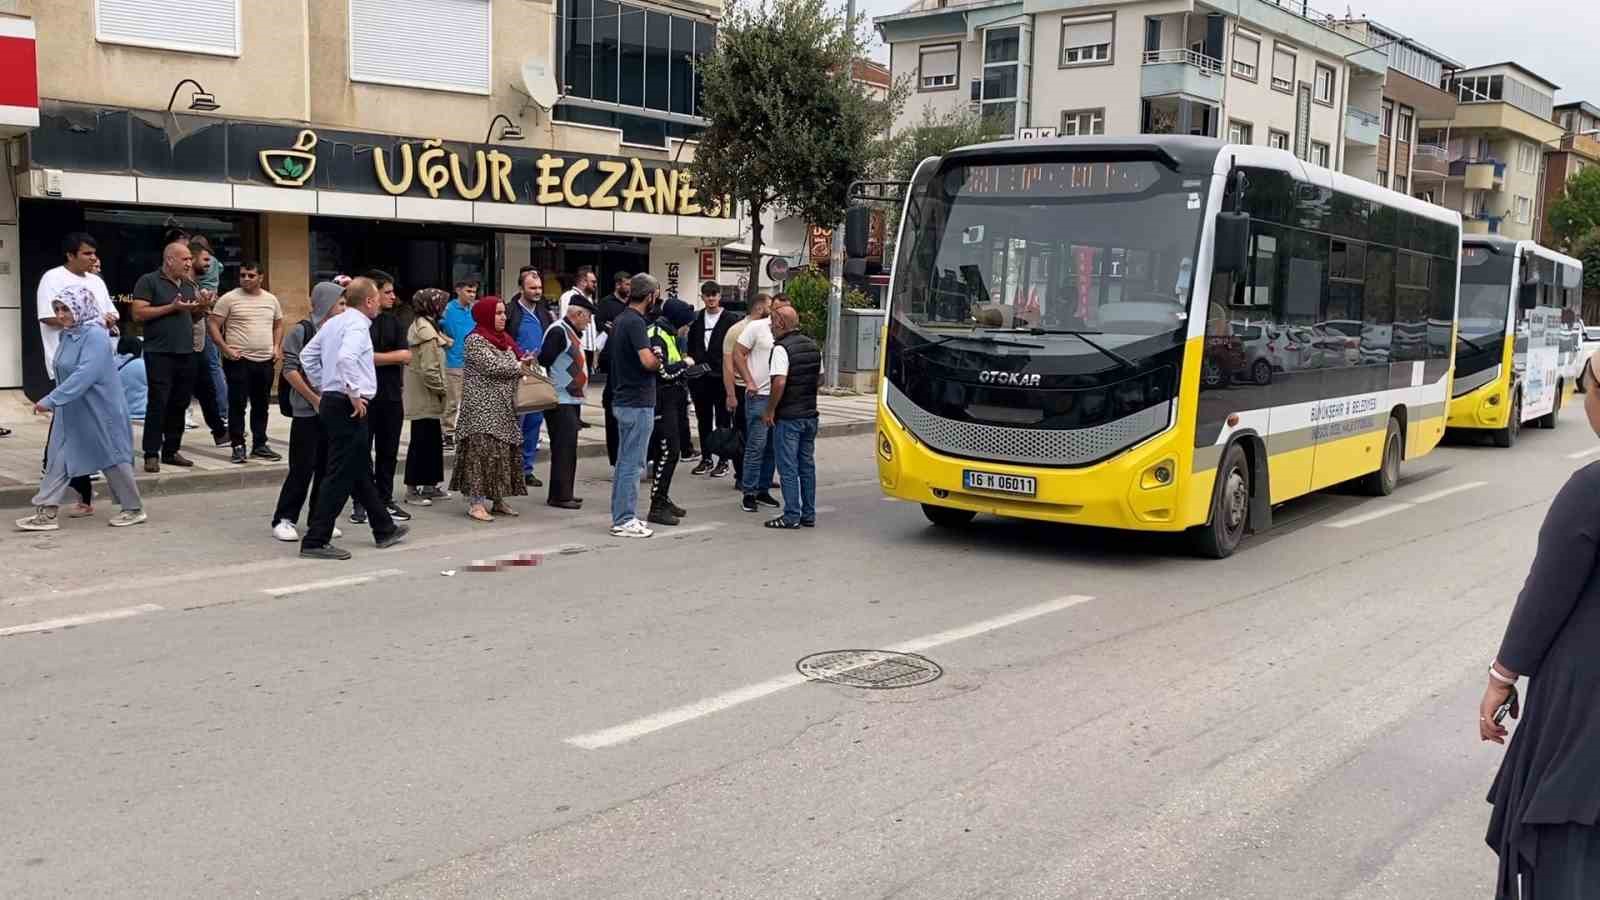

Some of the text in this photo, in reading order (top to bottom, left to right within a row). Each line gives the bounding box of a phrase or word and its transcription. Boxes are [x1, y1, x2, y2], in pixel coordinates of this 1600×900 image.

[374, 138, 516, 203] UĞUR
[703, 252, 713, 275] E
[979, 370, 1041, 386] OTOKAR
[971, 473, 983, 486] 16
[998, 476, 1032, 492] 06011
